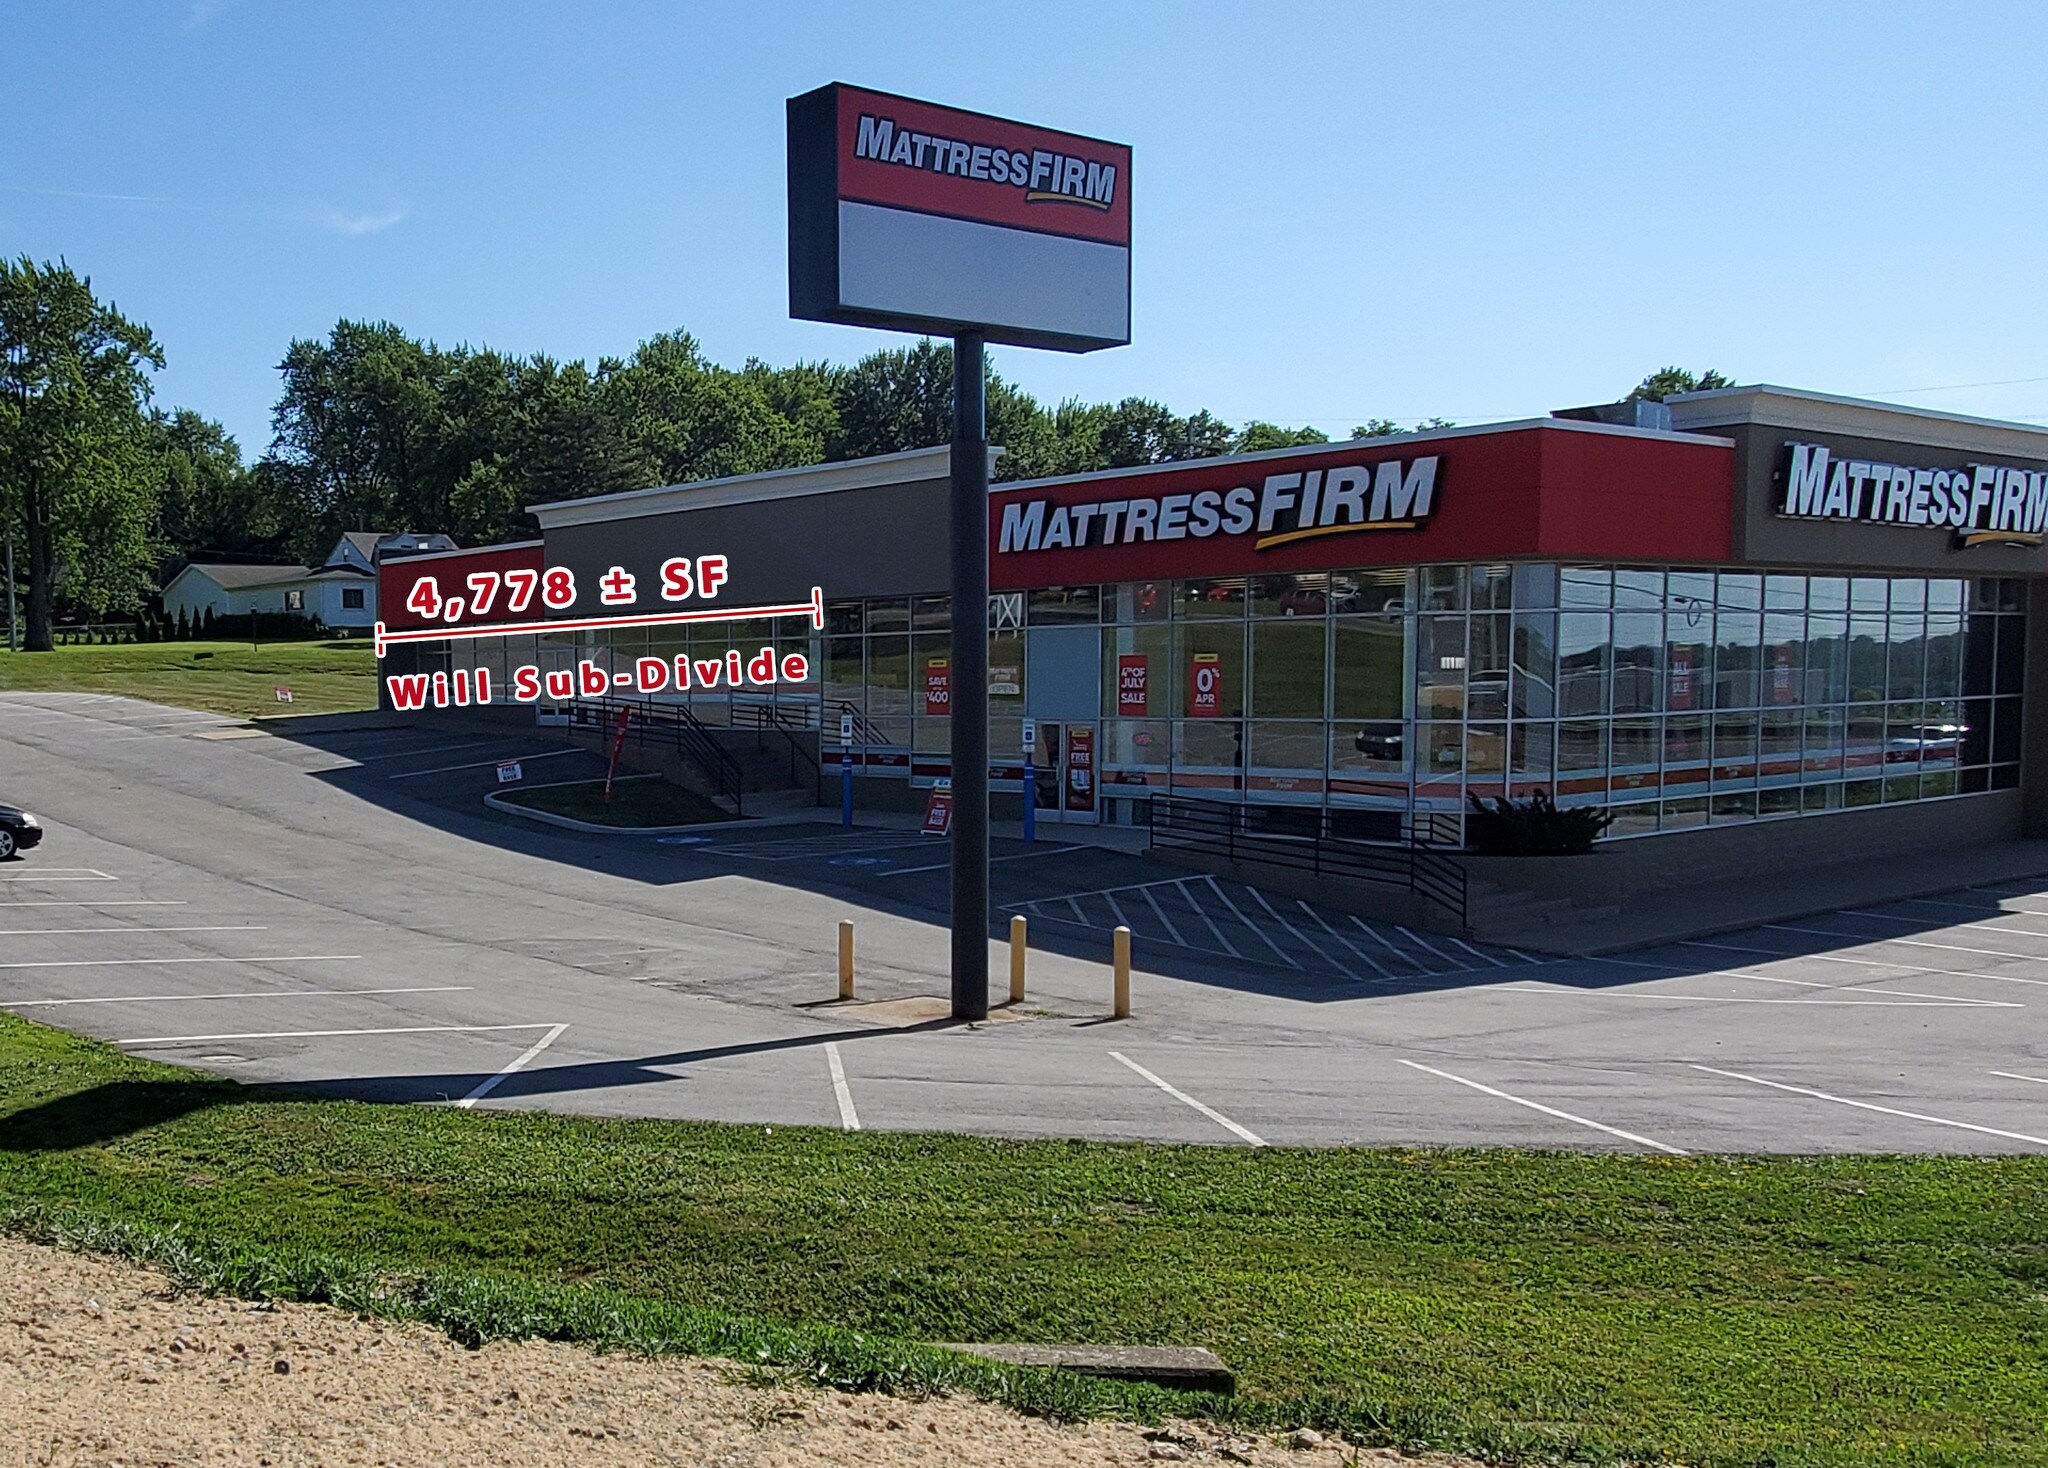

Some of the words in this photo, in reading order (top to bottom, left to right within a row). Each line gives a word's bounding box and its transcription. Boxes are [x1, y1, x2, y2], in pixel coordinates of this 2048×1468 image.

[928, 676, 948, 687] SAVE
[1120, 677, 1146, 689] JULY
[1120, 692, 1146, 704] SALE
[1195, 693, 1216, 704] APR
